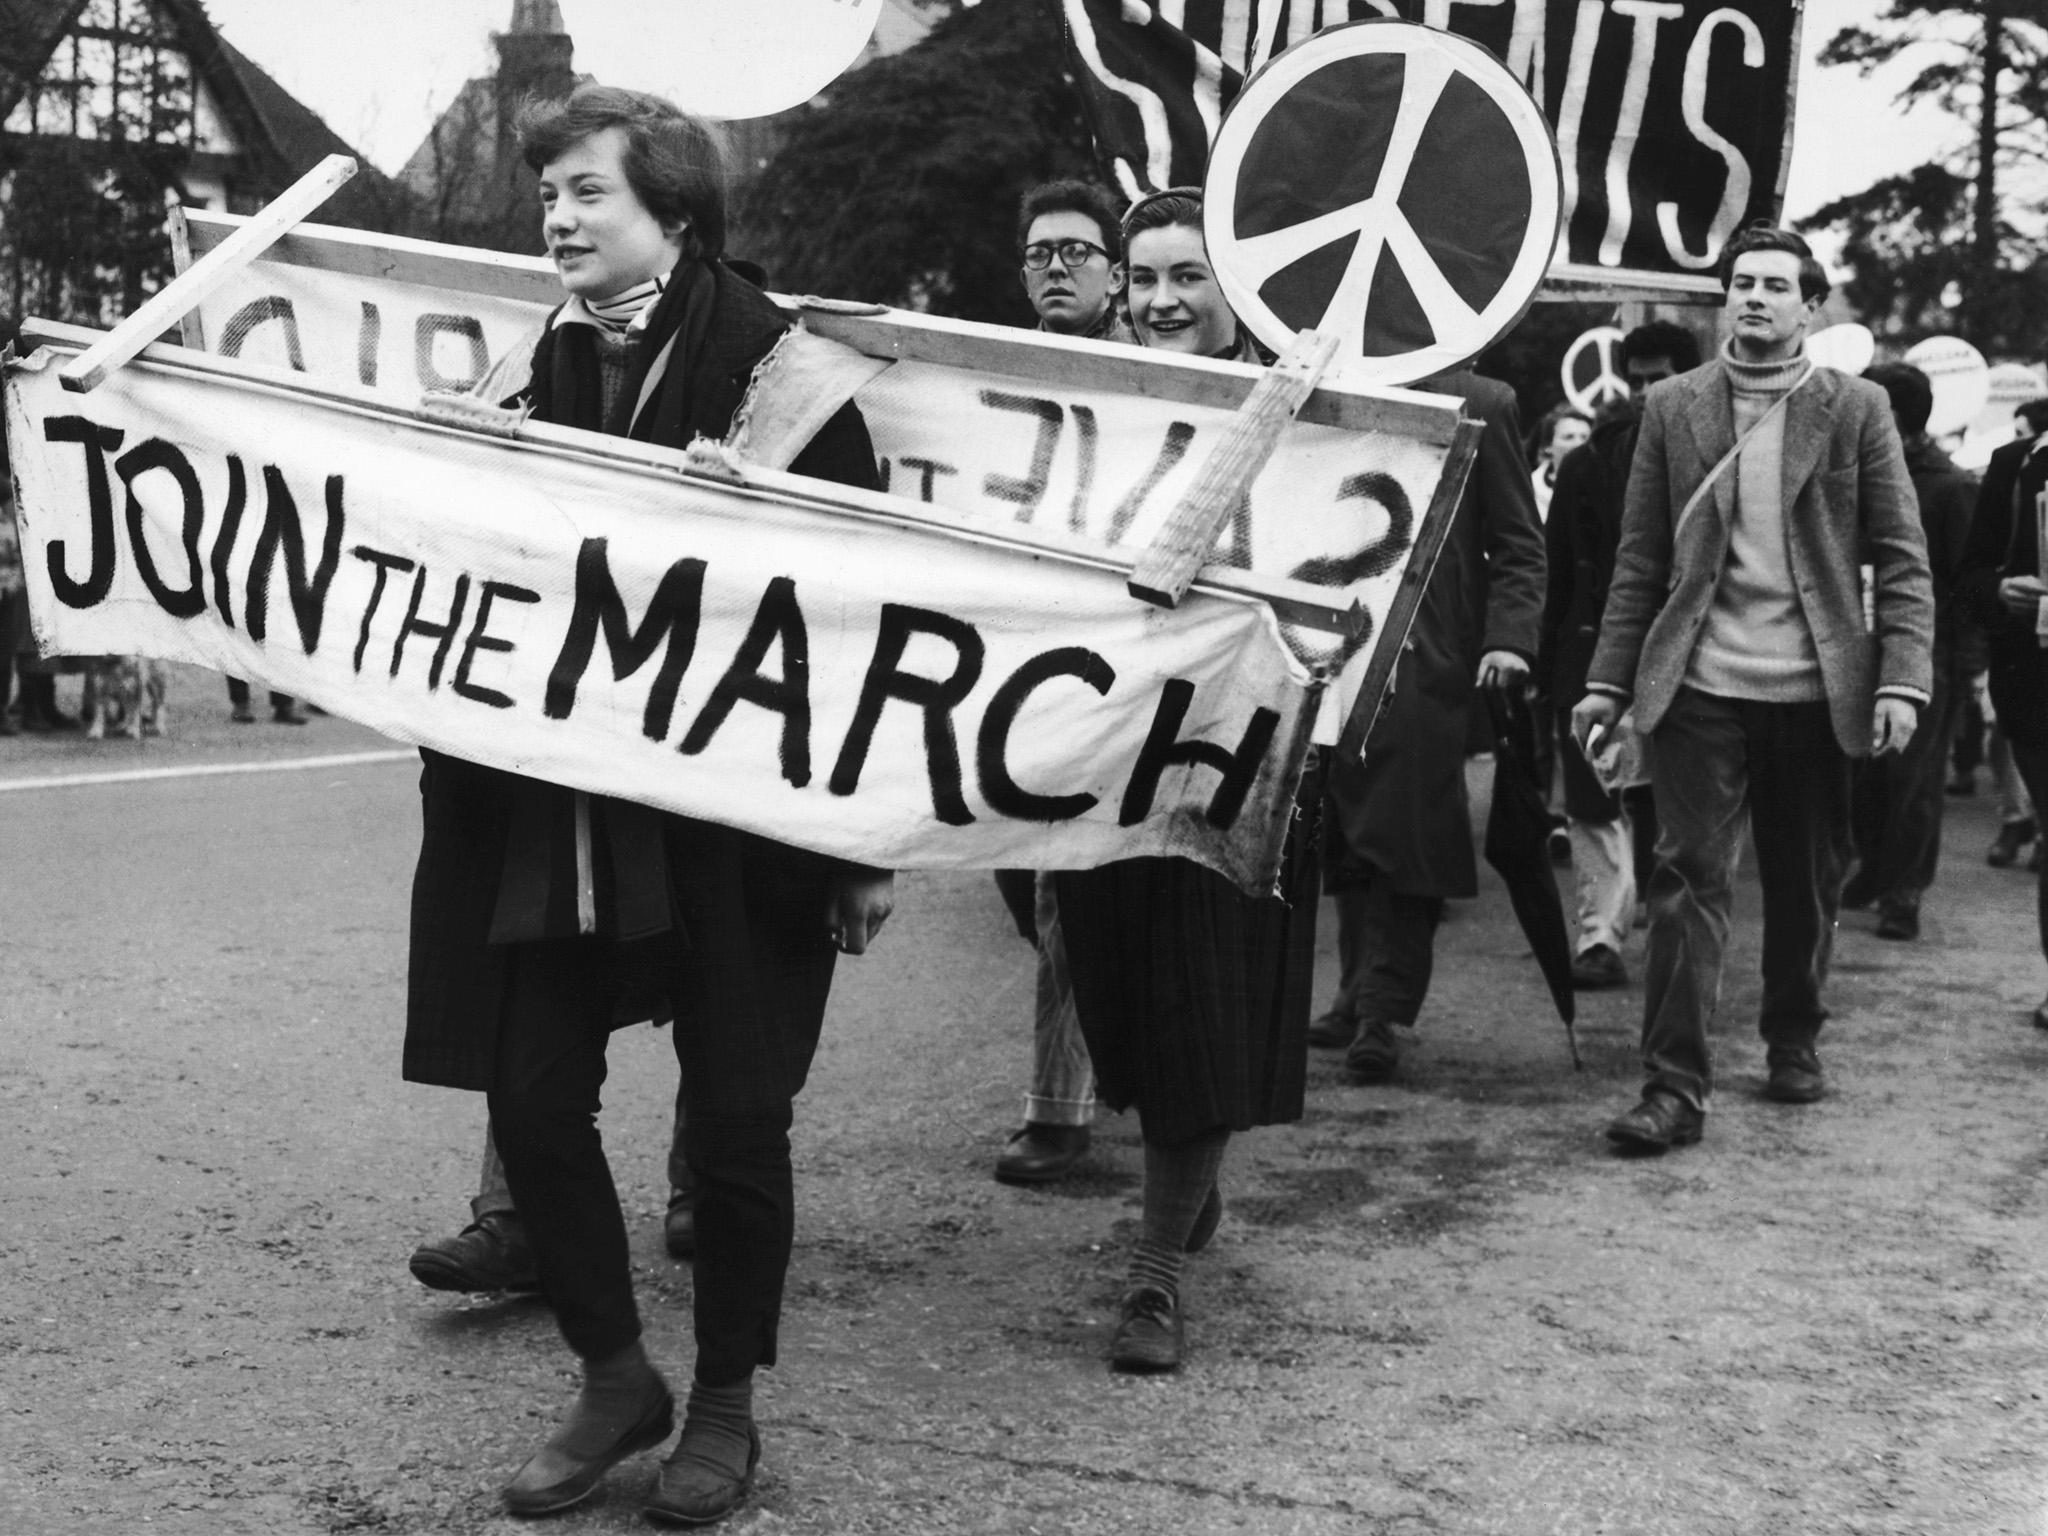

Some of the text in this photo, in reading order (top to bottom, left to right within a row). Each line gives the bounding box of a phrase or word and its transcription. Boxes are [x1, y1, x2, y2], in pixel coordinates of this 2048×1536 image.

[44, 415, 1281, 827] JOIN THE MARCH
